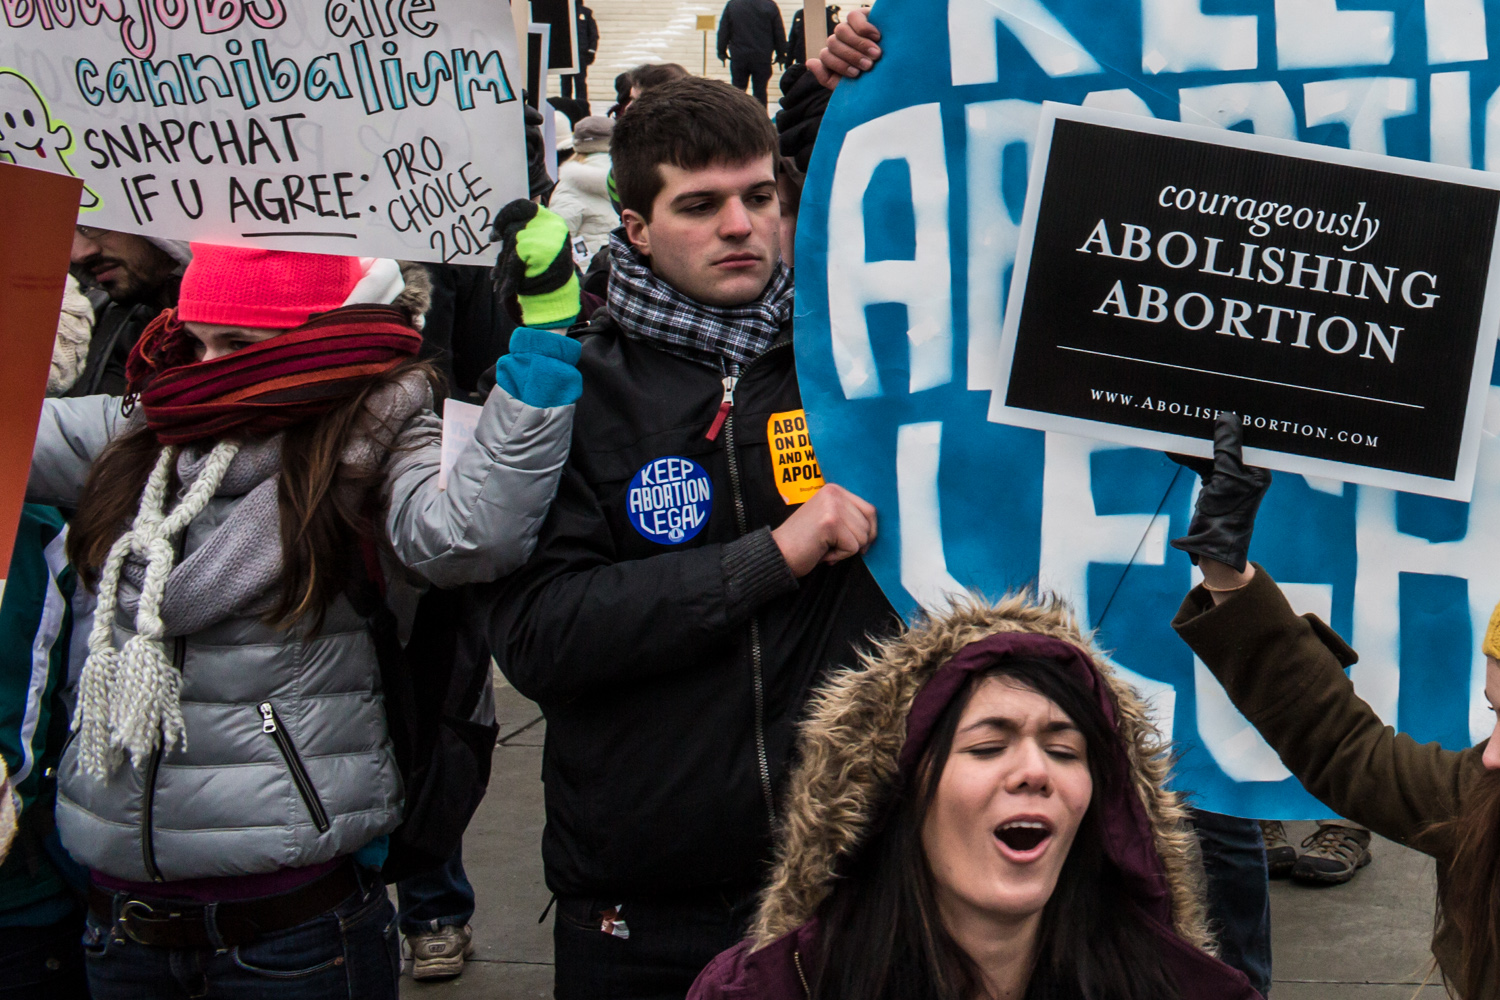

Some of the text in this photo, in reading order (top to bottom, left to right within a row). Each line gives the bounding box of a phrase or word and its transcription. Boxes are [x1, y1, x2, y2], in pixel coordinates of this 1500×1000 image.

[75, 38, 518, 116] cannibalism
[84, 112, 306, 170] SNAPCHAT
[382, 136, 444, 190] PRO
[121, 174, 159, 226] IF
[171, 178, 204, 220] U
[387, 161, 493, 233] CHOICE
[1158, 184, 1380, 252] courageously
[1076, 217, 1441, 310] ABOLISHING
[1093, 279, 1405, 364] ABORTION
[775, 436, 795, 450] ON
[778, 451, 802, 465] AND
[629, 477, 710, 514] ABORTION
[640, 458, 694, 485] KEEP
[639, 504, 706, 535] LEGAL
